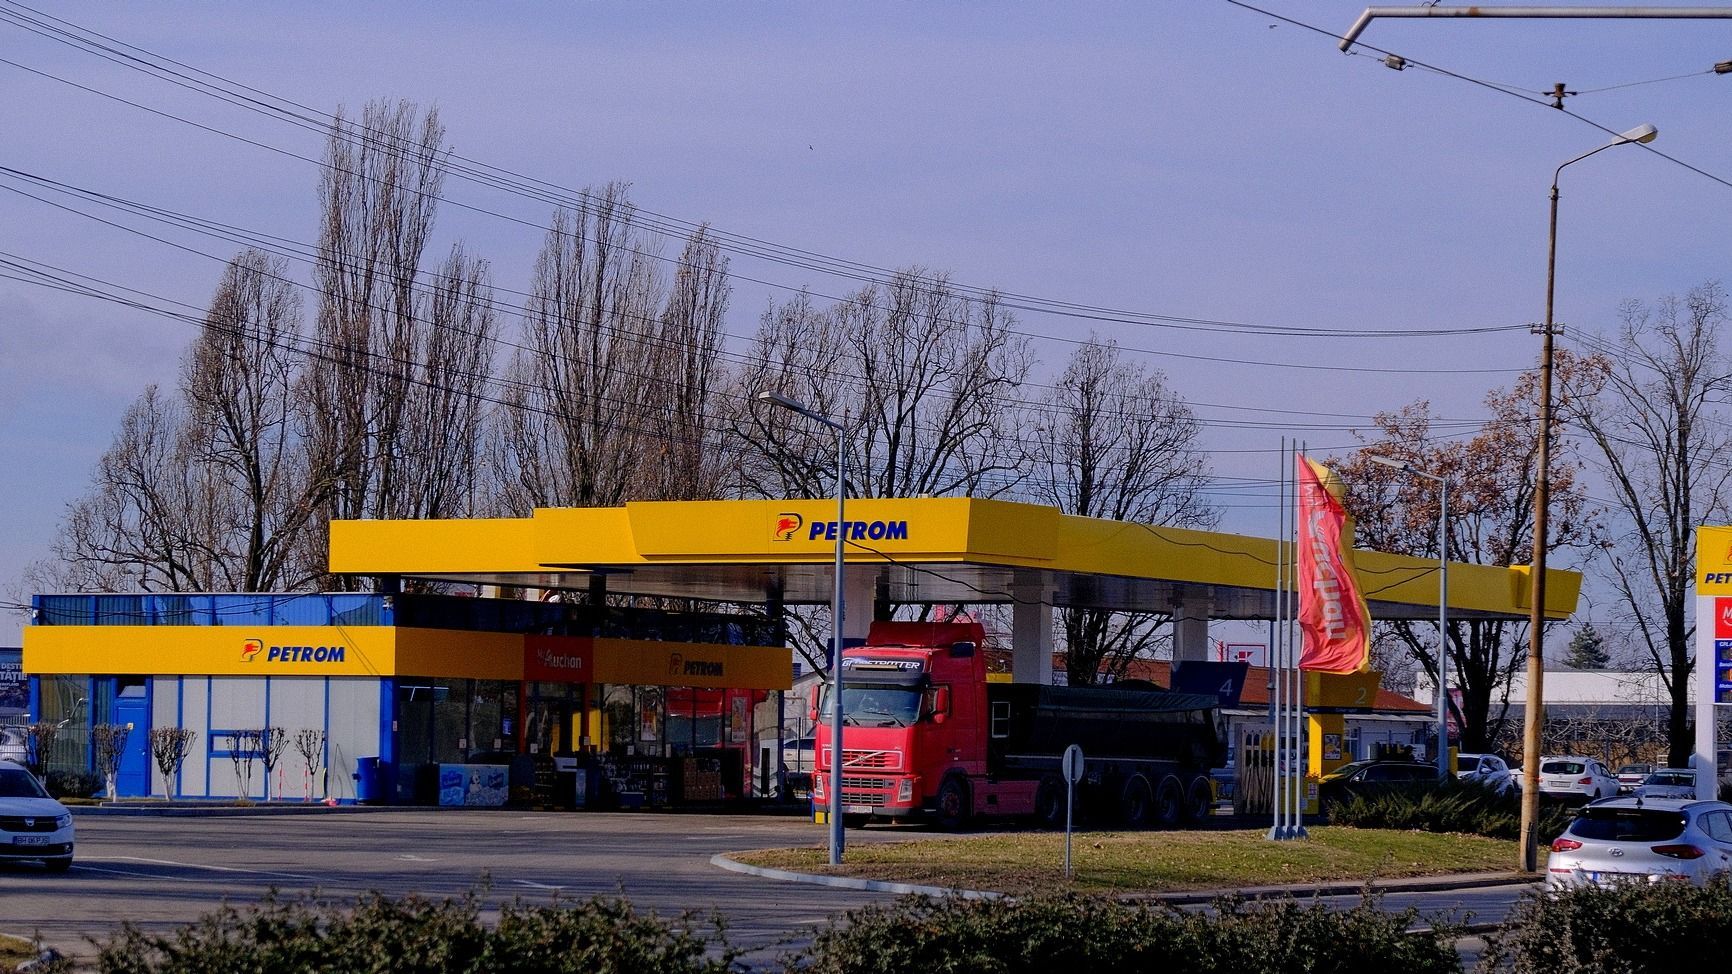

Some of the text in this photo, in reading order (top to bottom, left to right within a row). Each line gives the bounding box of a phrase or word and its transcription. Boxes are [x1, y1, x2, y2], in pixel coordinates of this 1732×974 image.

[808, 521, 908, 541] PETROM
[267, 646, 345, 662] PETROM
[544, 653, 582, 669] Auchan
[684, 660, 723, 677] PETROM
[1219, 678, 1233, 697] 4
[1355, 687, 1368, 704] 2
